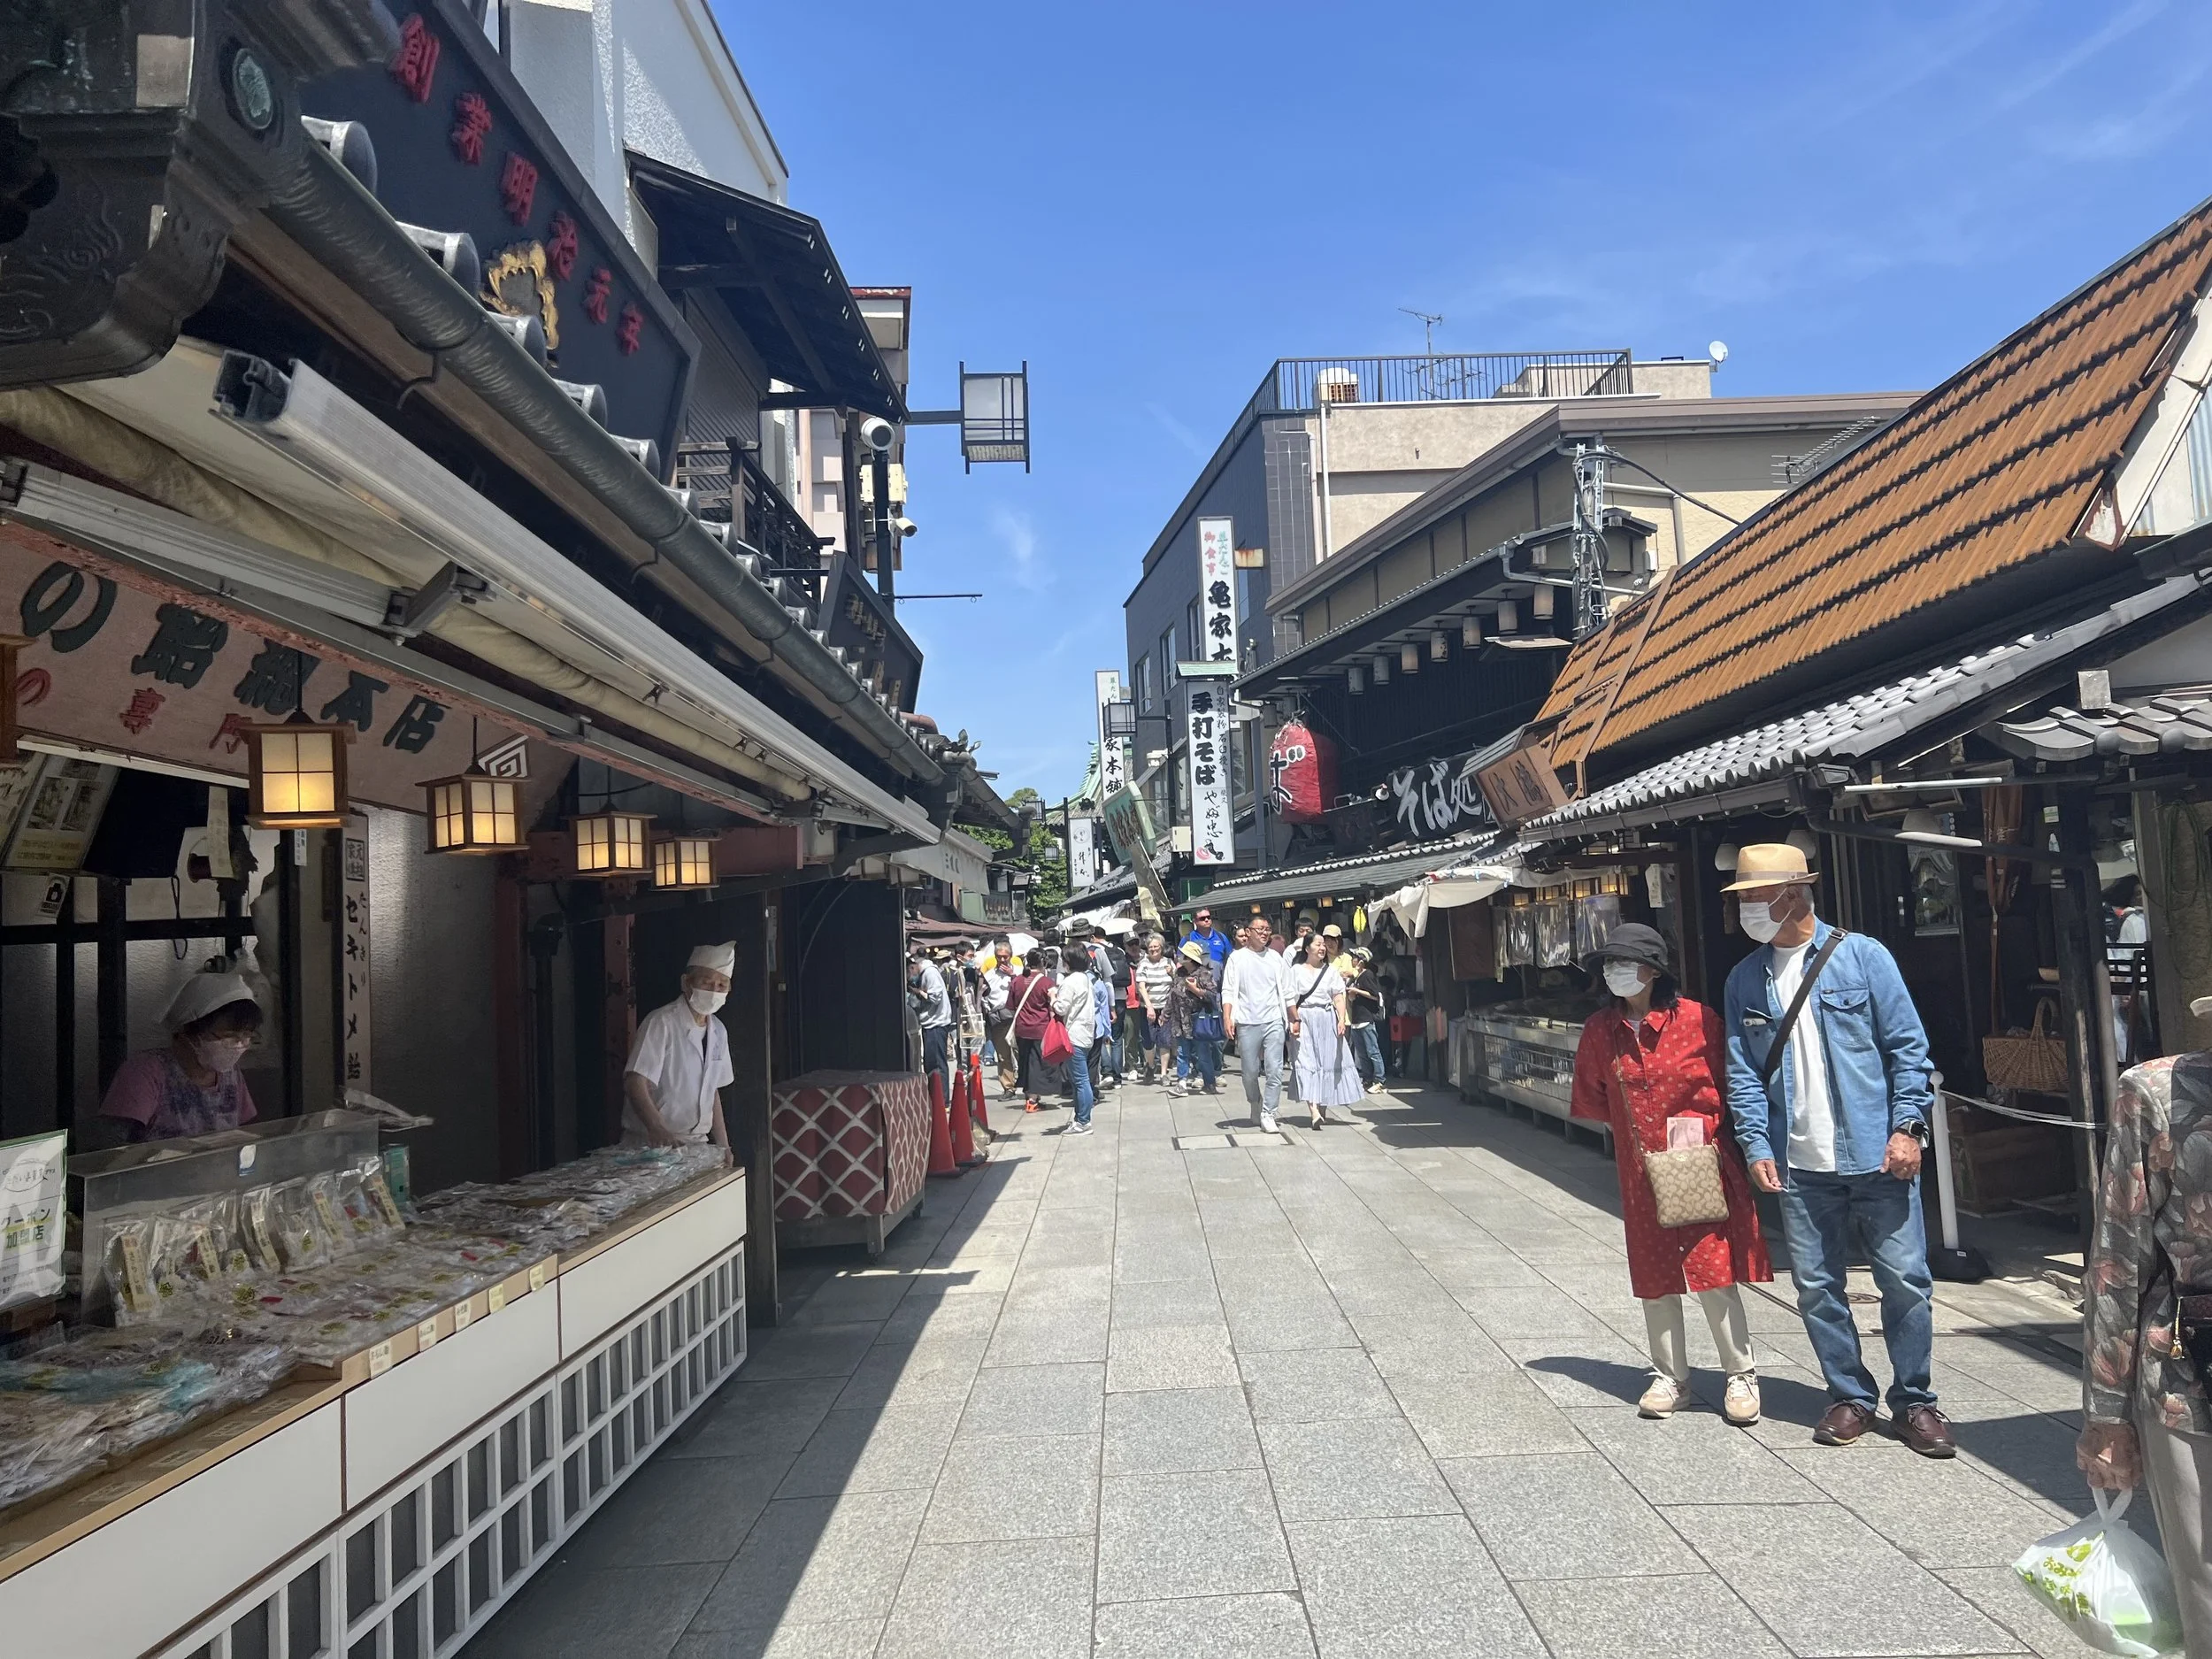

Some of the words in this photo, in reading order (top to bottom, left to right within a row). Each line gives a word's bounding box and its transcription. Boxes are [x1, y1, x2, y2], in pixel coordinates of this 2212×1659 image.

[392, 16, 644, 356] 創業明治元年
[1204, 531, 1216, 576] 御食事
[1191, 691, 1217, 786] 手打そば
